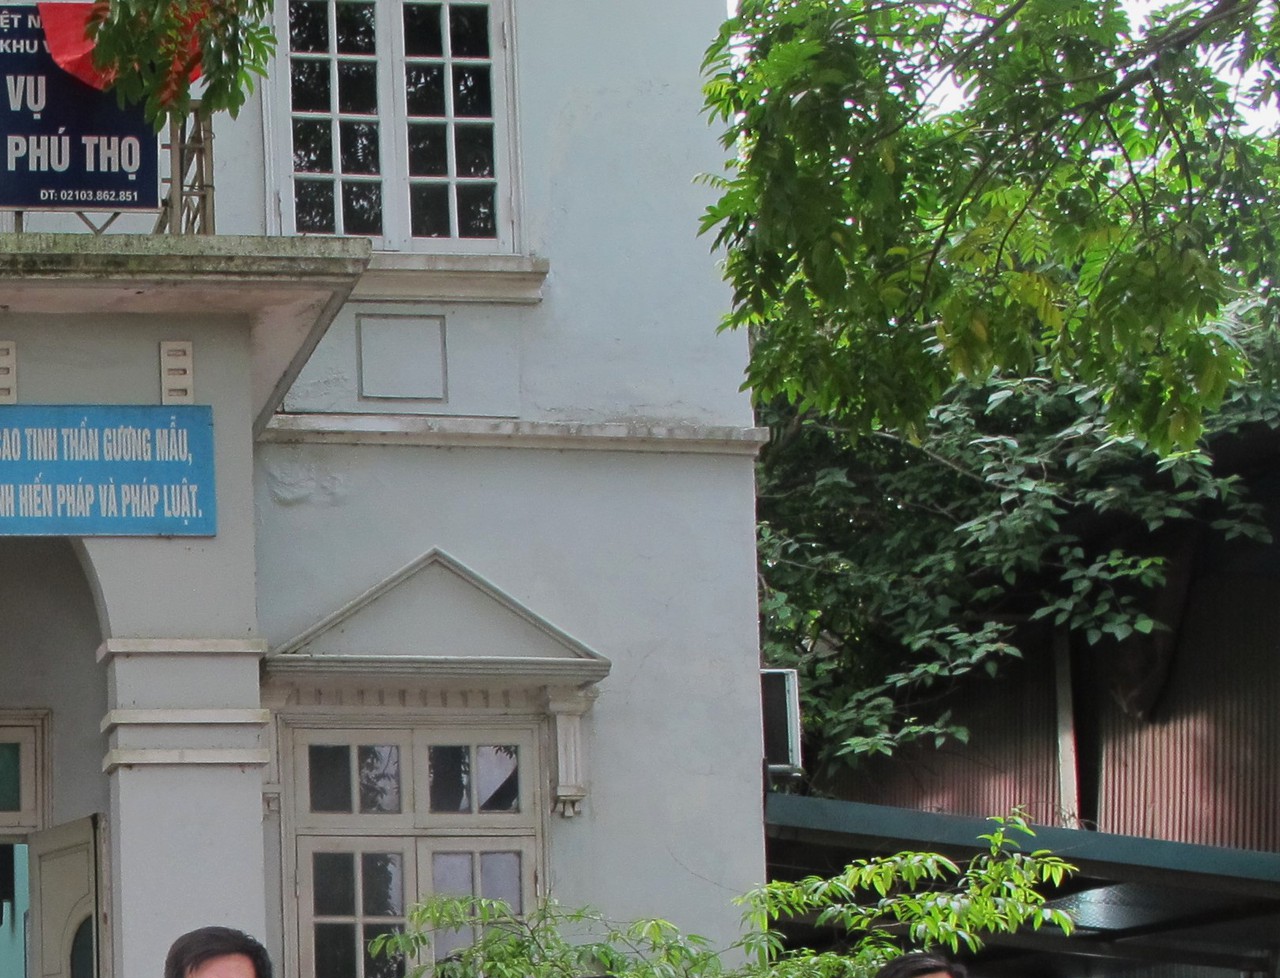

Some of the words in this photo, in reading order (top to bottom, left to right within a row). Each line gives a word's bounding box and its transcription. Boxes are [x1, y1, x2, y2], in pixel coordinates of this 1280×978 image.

[0, 39, 38, 53] KHU
[6, 75, 46, 120] VỤ
[7, 127, 70, 172] PHÚ
[81, 135, 140, 180] THỌ
[24, 428, 58, 461] TINH
[103, 425, 151, 461] GƯƠNG
[19, 472, 53, 518] HIẾN
[56, 477, 95, 517] PHÁP
[98, 477, 118, 517] VÀ
[121, 477, 159, 517] PHÁP
